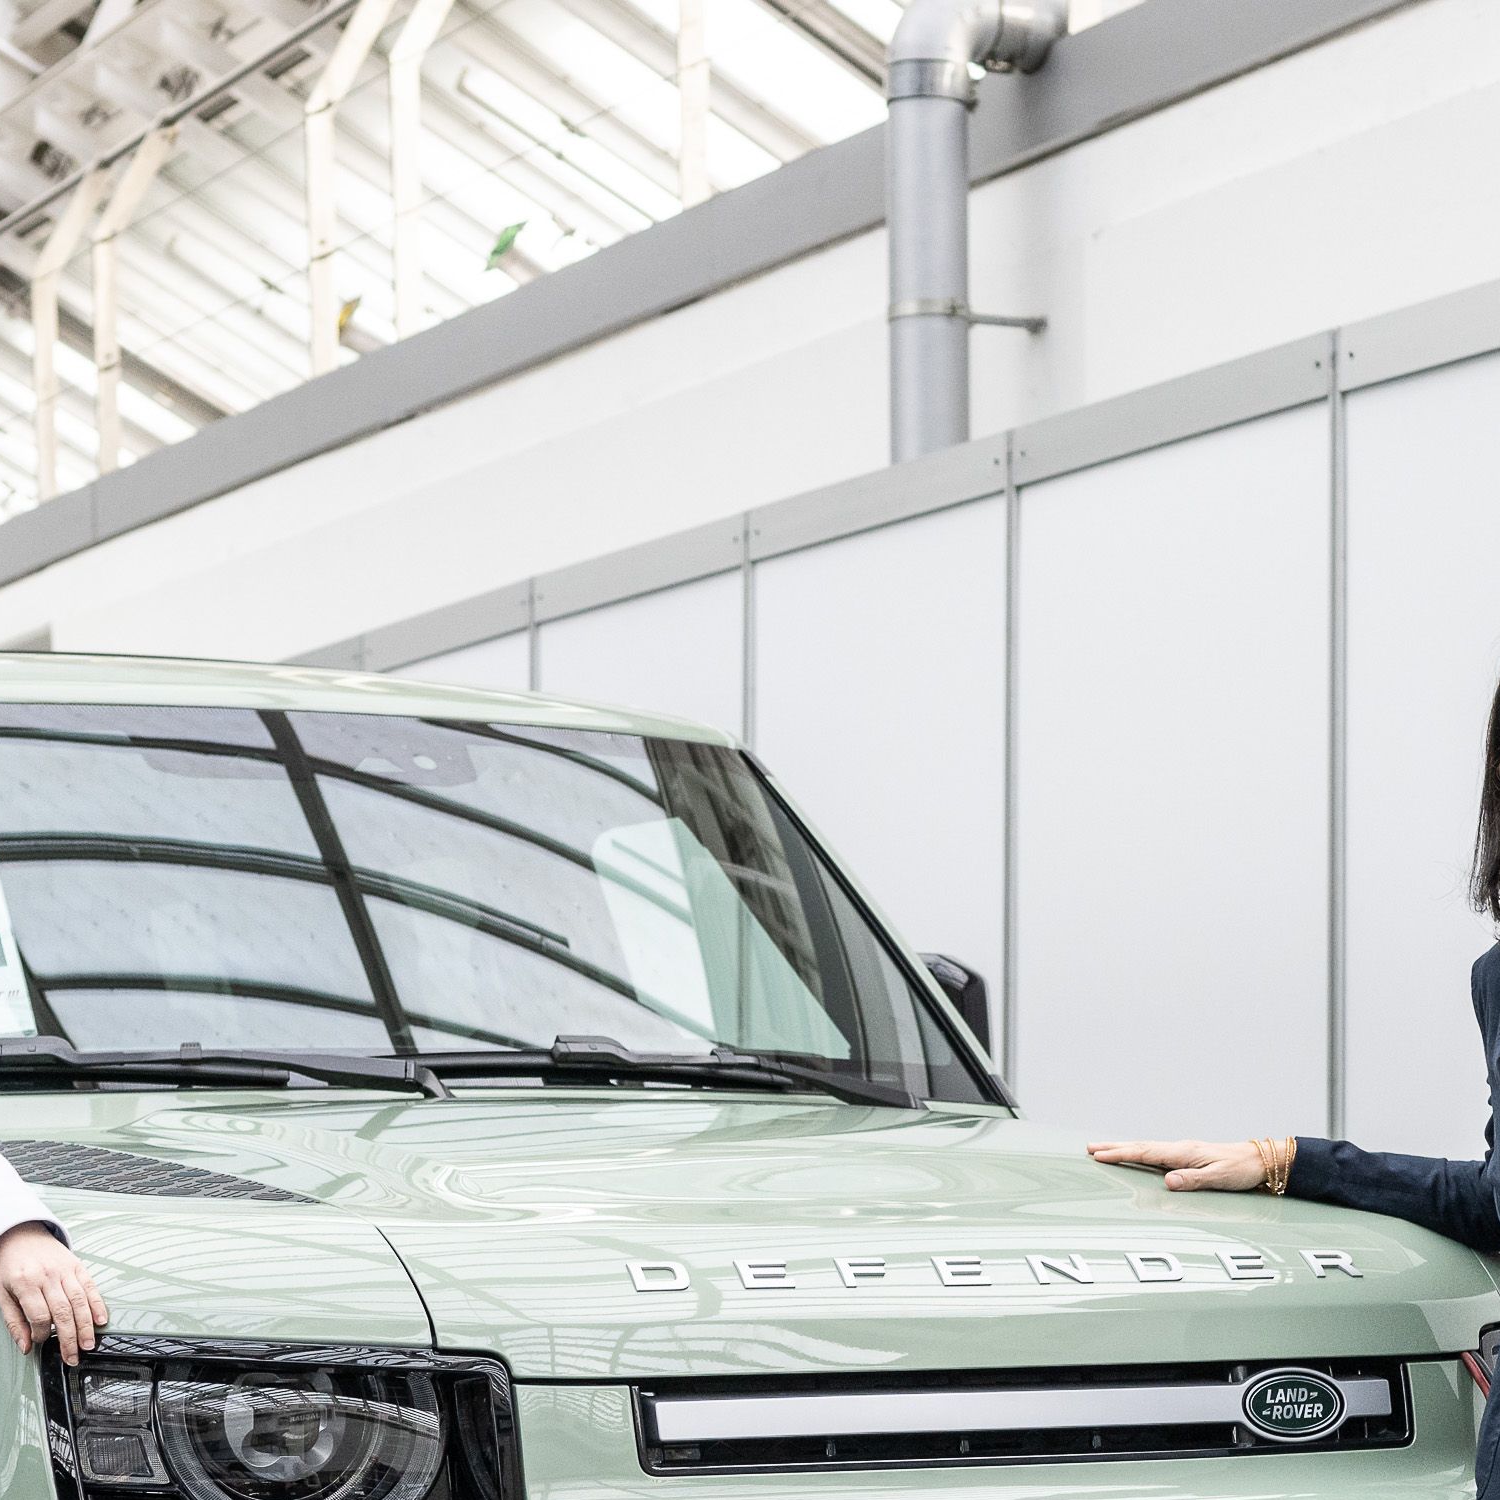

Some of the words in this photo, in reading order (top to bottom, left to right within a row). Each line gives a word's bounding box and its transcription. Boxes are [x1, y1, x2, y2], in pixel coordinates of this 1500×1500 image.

[624, 1248, 1364, 1293] DEFENDER
[1265, 1387, 1308, 1404] LAND
[1271, 1403, 1324, 1420] ROVER
